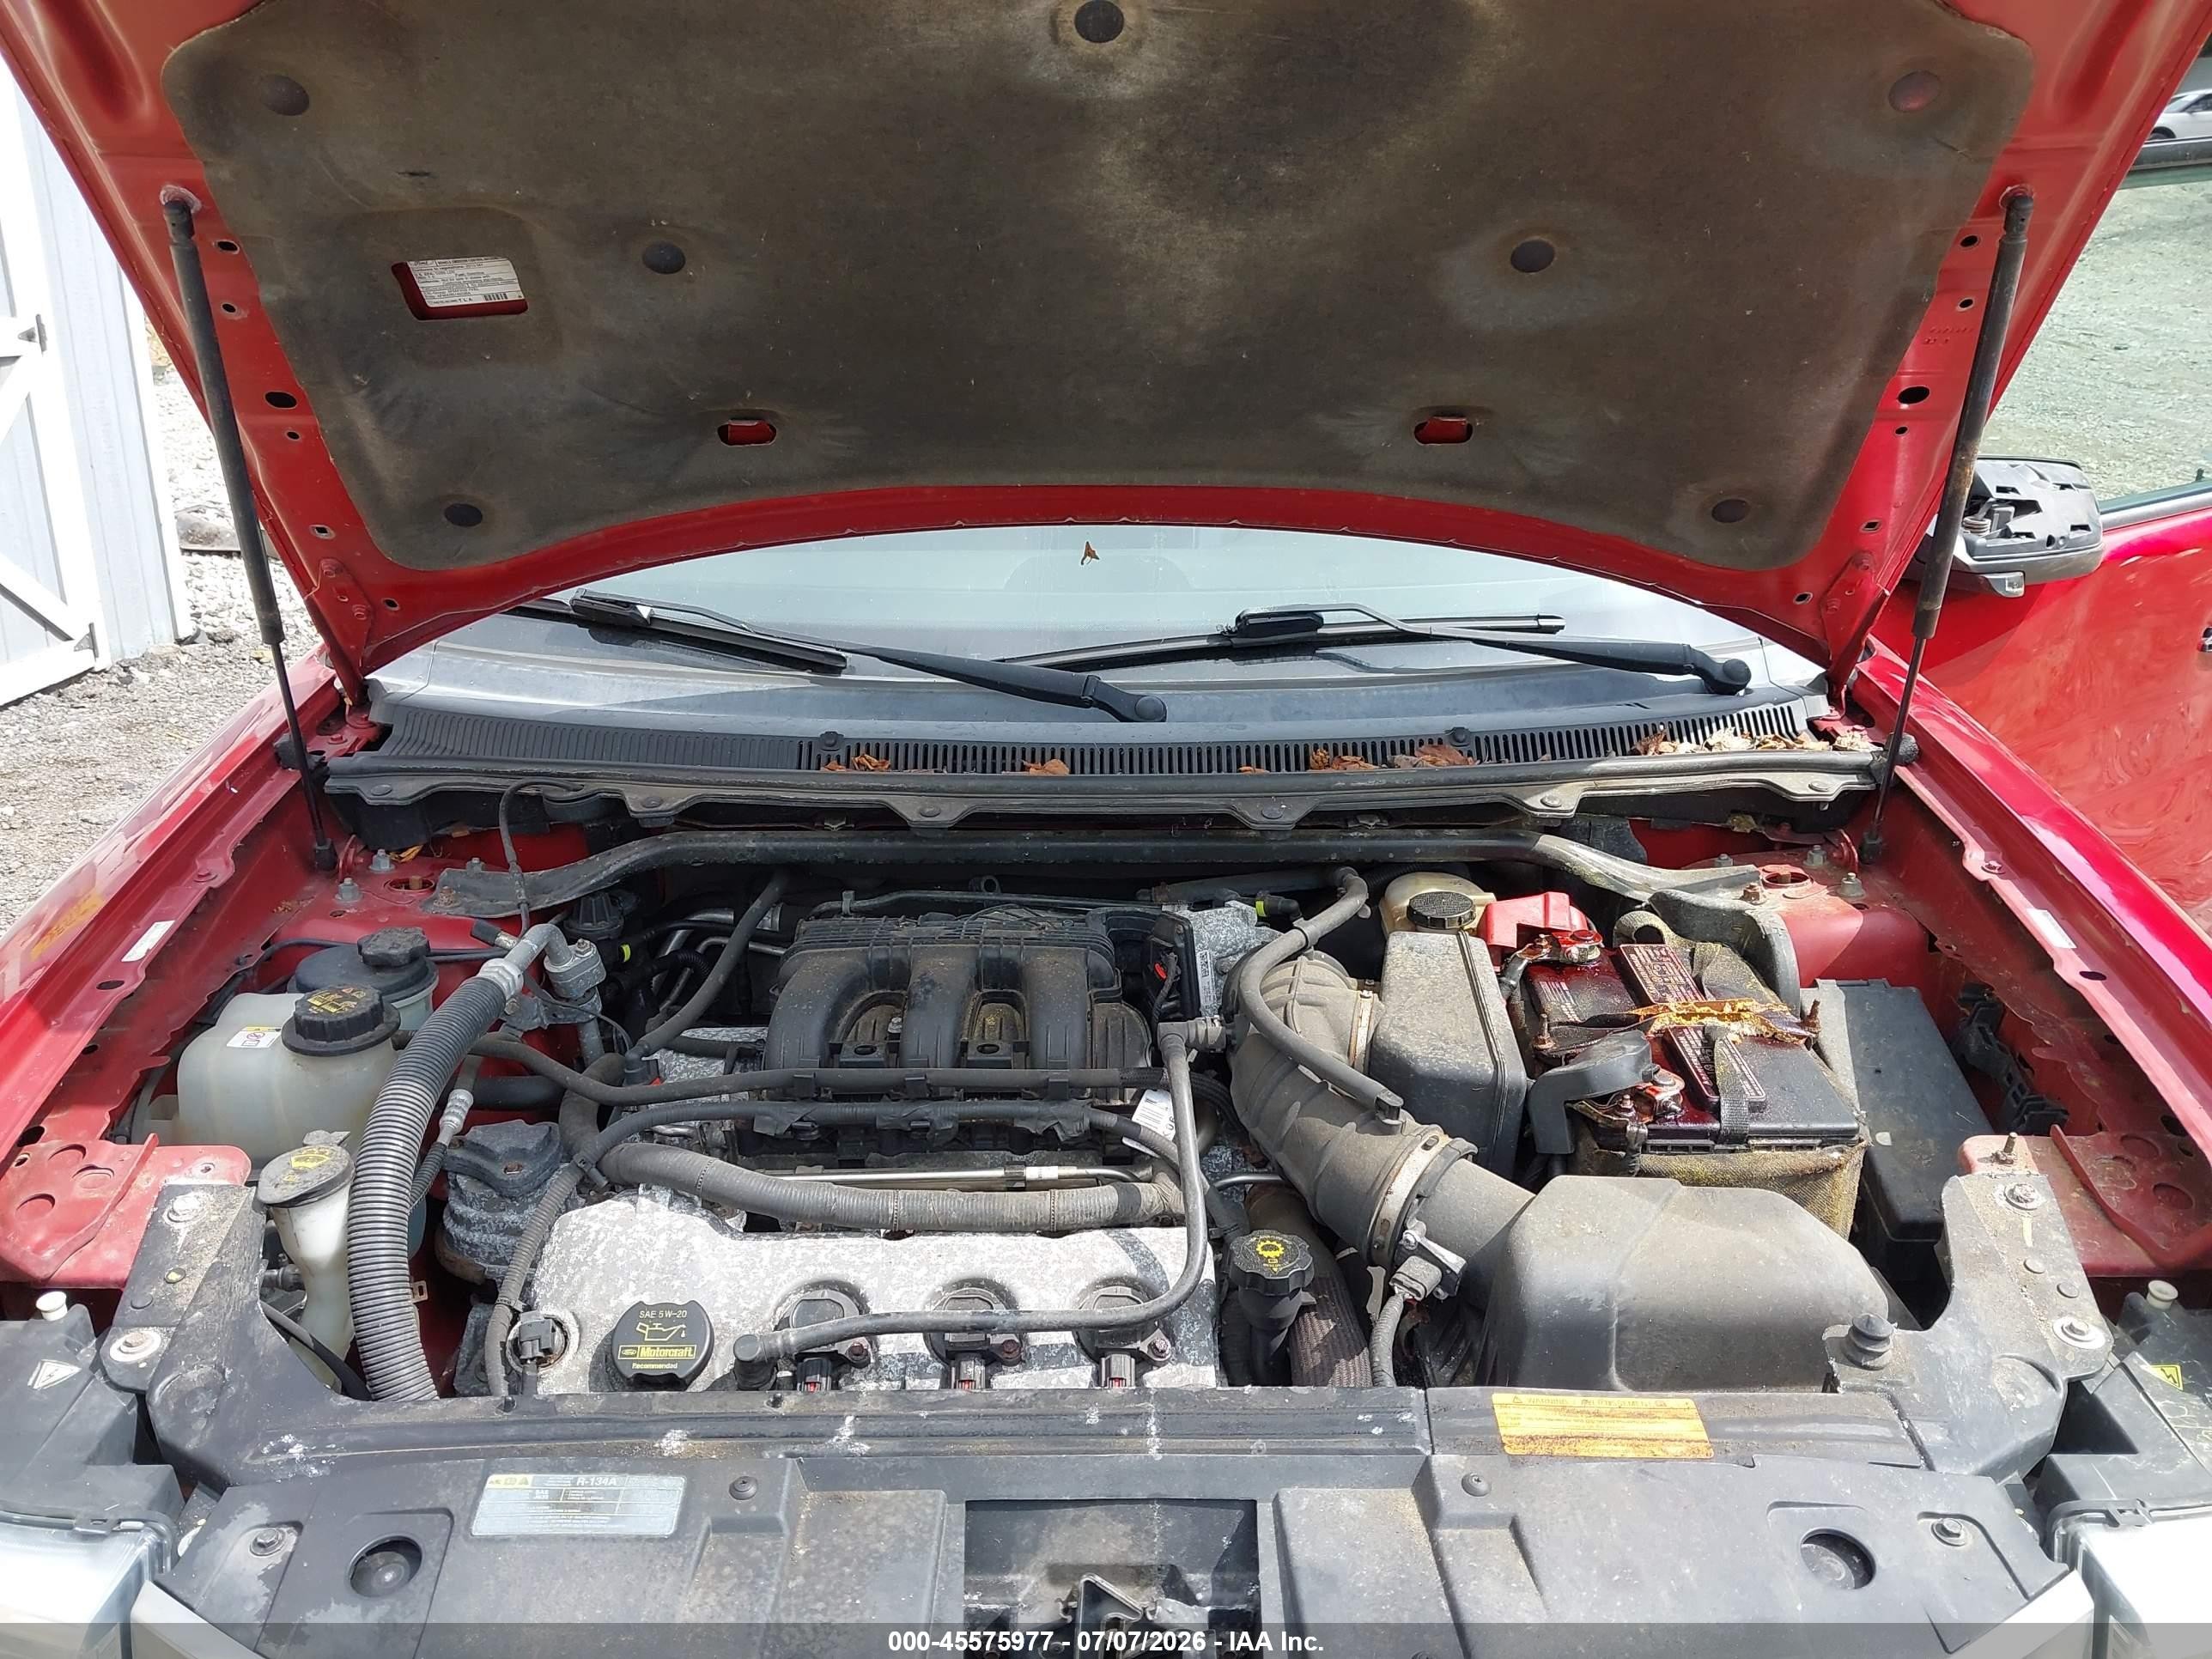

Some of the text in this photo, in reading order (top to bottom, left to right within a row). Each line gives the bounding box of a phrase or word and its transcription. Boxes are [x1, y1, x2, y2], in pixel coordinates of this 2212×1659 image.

[639, 1310, 657, 1319] SAE
[640, 1346, 694, 1358] Motorcraft
[576, 1476, 617, 1486] R-134A
